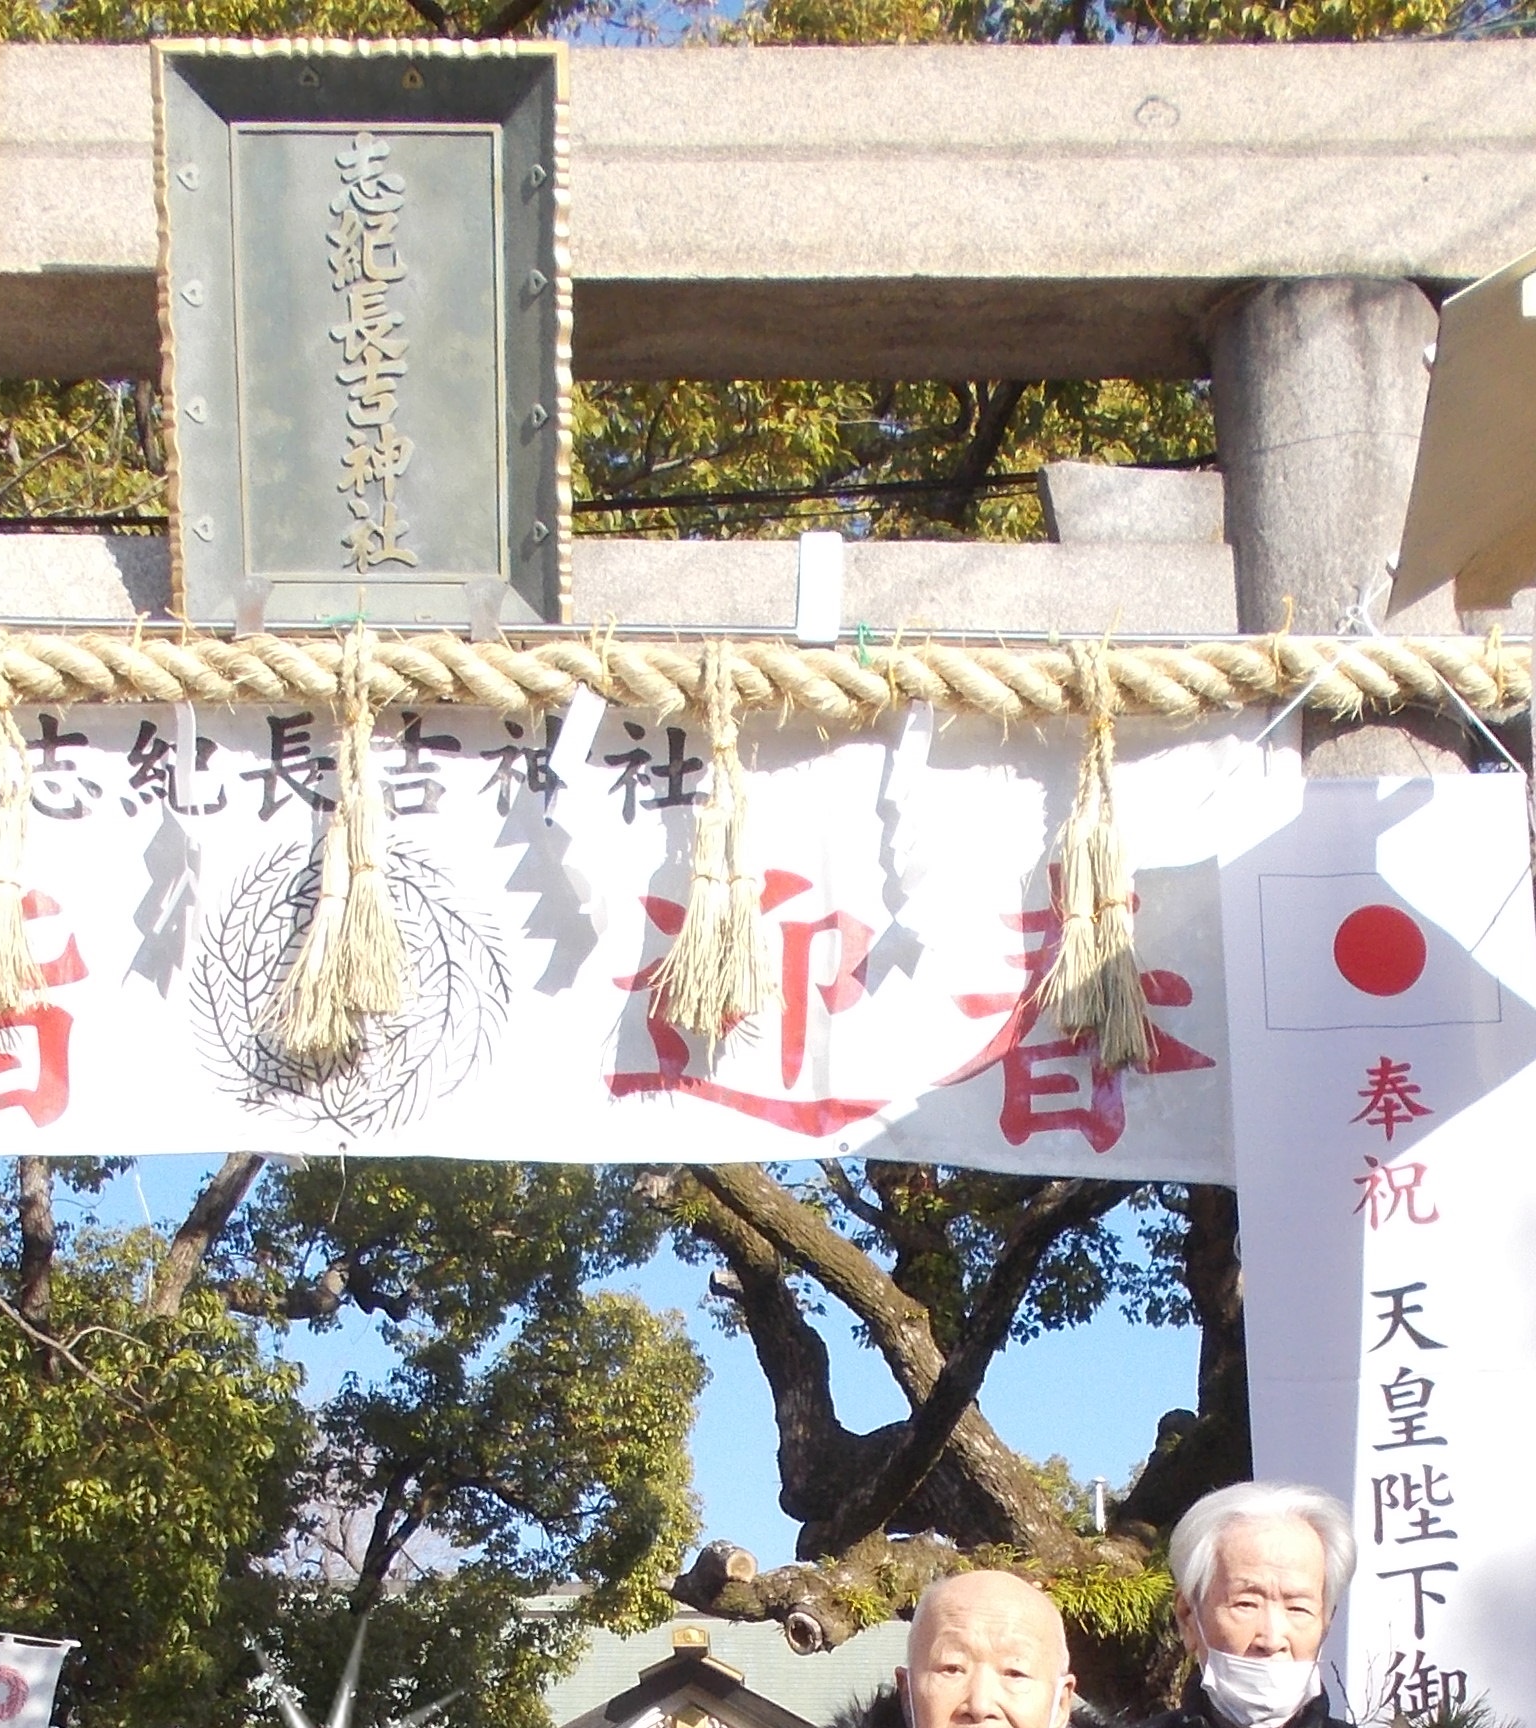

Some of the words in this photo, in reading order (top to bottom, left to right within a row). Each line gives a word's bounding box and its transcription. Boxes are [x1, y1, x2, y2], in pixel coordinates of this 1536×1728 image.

[326, 131, 418, 574] 志紀長吉神社
[28, 712, 709, 824] 志紀長吉神社
[1349, 1056, 1440, 1230] 奉祝
[1367, 1281, 1468, 1720] 天皇陛下御
